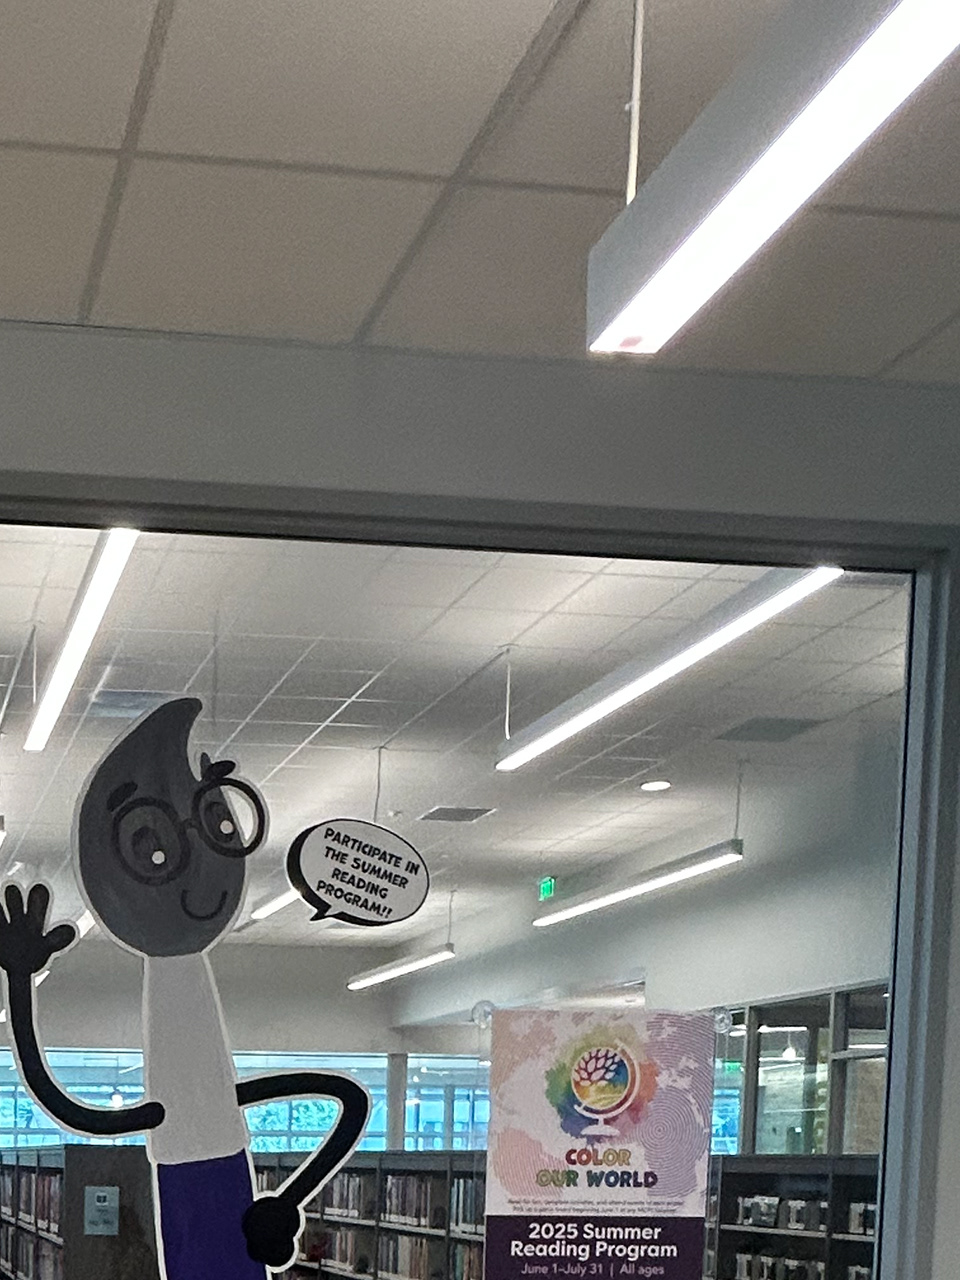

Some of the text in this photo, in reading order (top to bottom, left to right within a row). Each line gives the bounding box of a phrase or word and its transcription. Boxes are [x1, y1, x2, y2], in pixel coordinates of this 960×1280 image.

[324, 827, 420, 875] PARTICIPATE IN
[324, 846, 409, 889] THE SUMMER
[331, 867, 389, 899] READING
[316, 880, 393, 918] PROGRAM!!
[565, 1149, 632, 1166] COLOR
[535, 1169, 659, 1188] OUR WORLD
[528, 1223, 662, 1241] 2025 Summer
[510, 1240, 678, 1261] Reading Program
[521, 1263, 548, 1275] June
[590, 1263, 603, 1274] 31
[619, 1263, 635, 1275] All
[638, 1264, 665, 1277] ages
